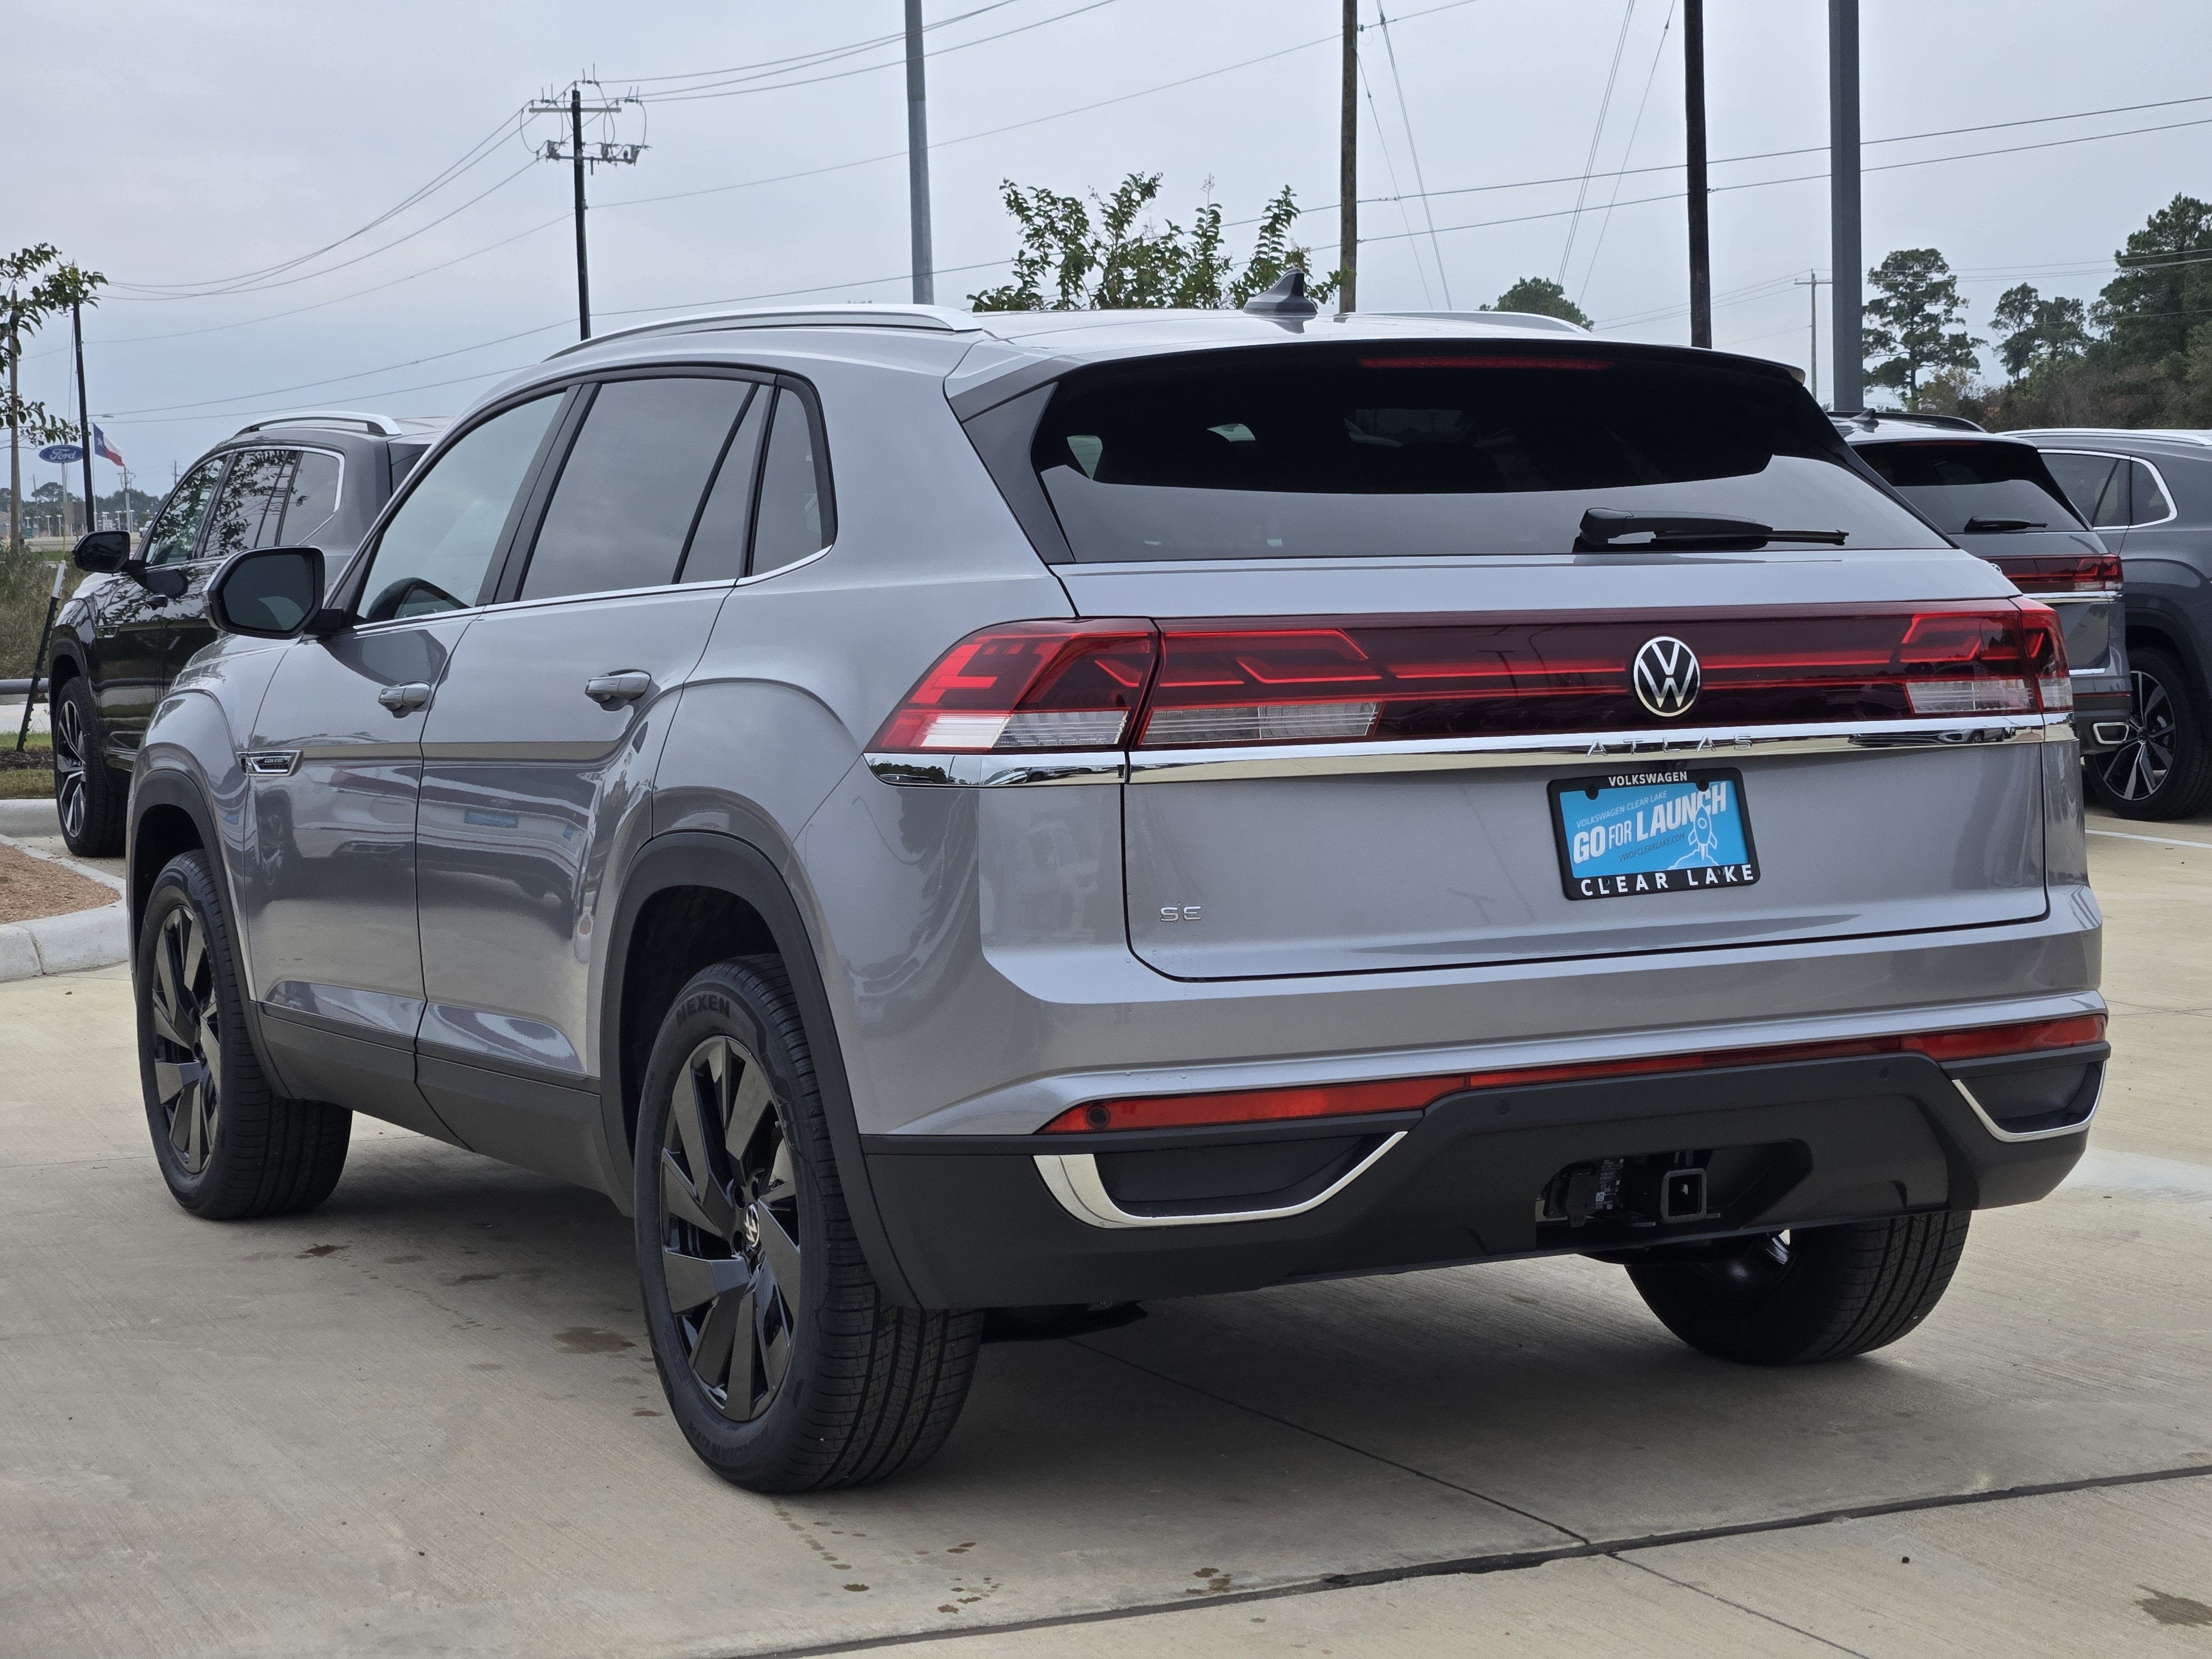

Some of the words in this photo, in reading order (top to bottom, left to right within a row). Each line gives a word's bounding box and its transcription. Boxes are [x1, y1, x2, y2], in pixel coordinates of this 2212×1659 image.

[49, 448, 77, 460] Ford
[1585, 733, 1752, 757] ATLAS
[1608, 771, 1688, 786] VOLKSWAGEN
[1573, 826, 1605, 864] GO
[1608, 820, 1632, 850] FOR
[1636, 781, 1726, 842] LAUNCH
[1576, 805, 1625, 828] VOLKSWAGEN
[1626, 798, 1648, 811] CLEAR
[1650, 790, 1667, 802] LAKE
[1618, 833, 1685, 862] VWOFCLEARLAKE.COM
[1580, 872, 1669, 896] CLEAR
[1687, 864, 1754, 886] LAKE
[1160, 906, 1202, 921] SE
[676, 994, 730, 1026] NEXEN
